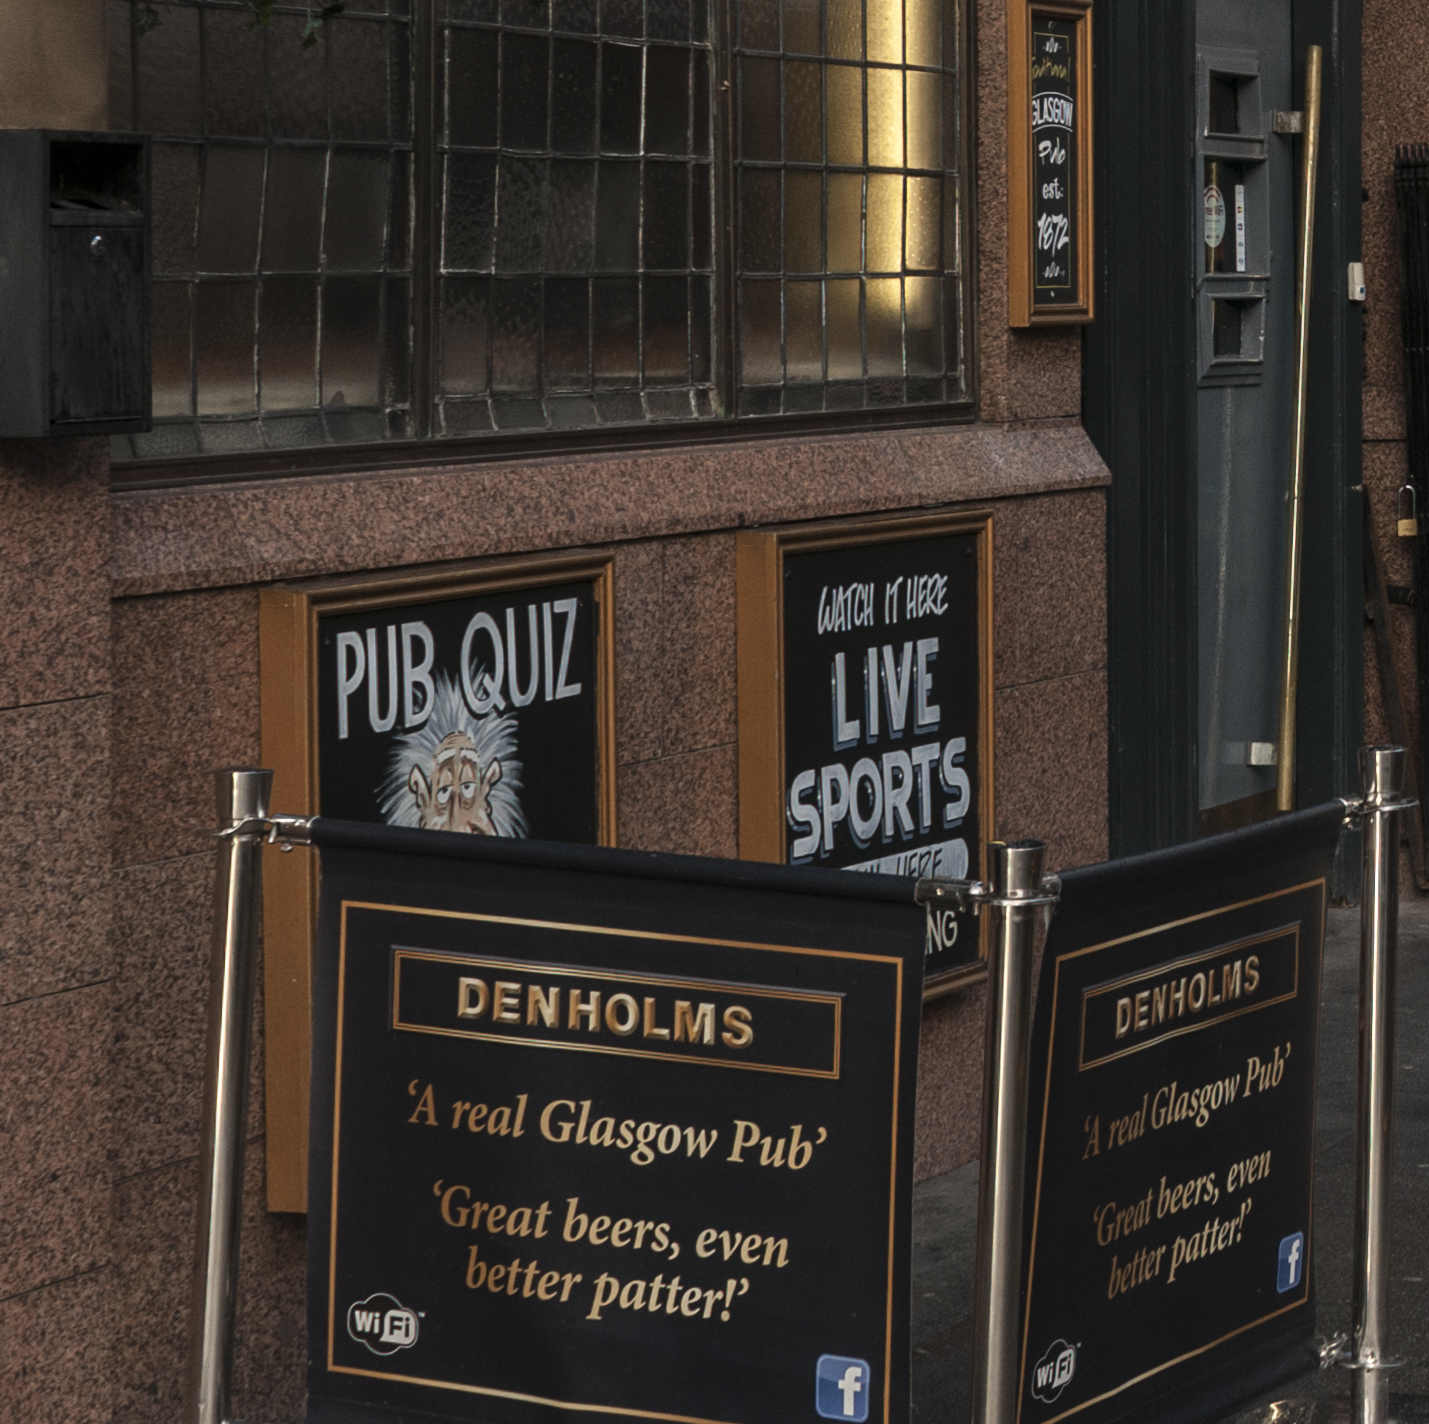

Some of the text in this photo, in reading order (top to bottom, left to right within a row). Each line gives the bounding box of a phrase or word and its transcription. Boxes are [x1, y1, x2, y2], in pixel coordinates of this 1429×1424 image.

[1031, 95, 1073, 127] GLASGOW
[1038, 136, 1067, 166] Pub
[1037, 212, 1070, 258] 1872
[817, 572, 949, 636] WATCH IT HERE
[335, 596, 584, 740] PUB QUIZ
[831, 635, 945, 753] LIVE
[786, 736, 972, 866] SPORTS
[456, 976, 755, 1048] DENHOLMS
[1114, 954, 1261, 1040] DENHOLMS
[448, 1092, 529, 1137] real
[537, 1097, 718, 1165] Glasgow
[1107, 1092, 1149, 1152] real
[1150, 1070, 1241, 1129] Glasgow
[1155, 1170, 1220, 1220] beers,
[1226, 1148, 1273, 1189] even
[562, 1197, 681, 1261] beers,
[695, 1227, 790, 1269] even
[465, 1245, 584, 1303] better
[1107, 1242, 1168, 1300] better
